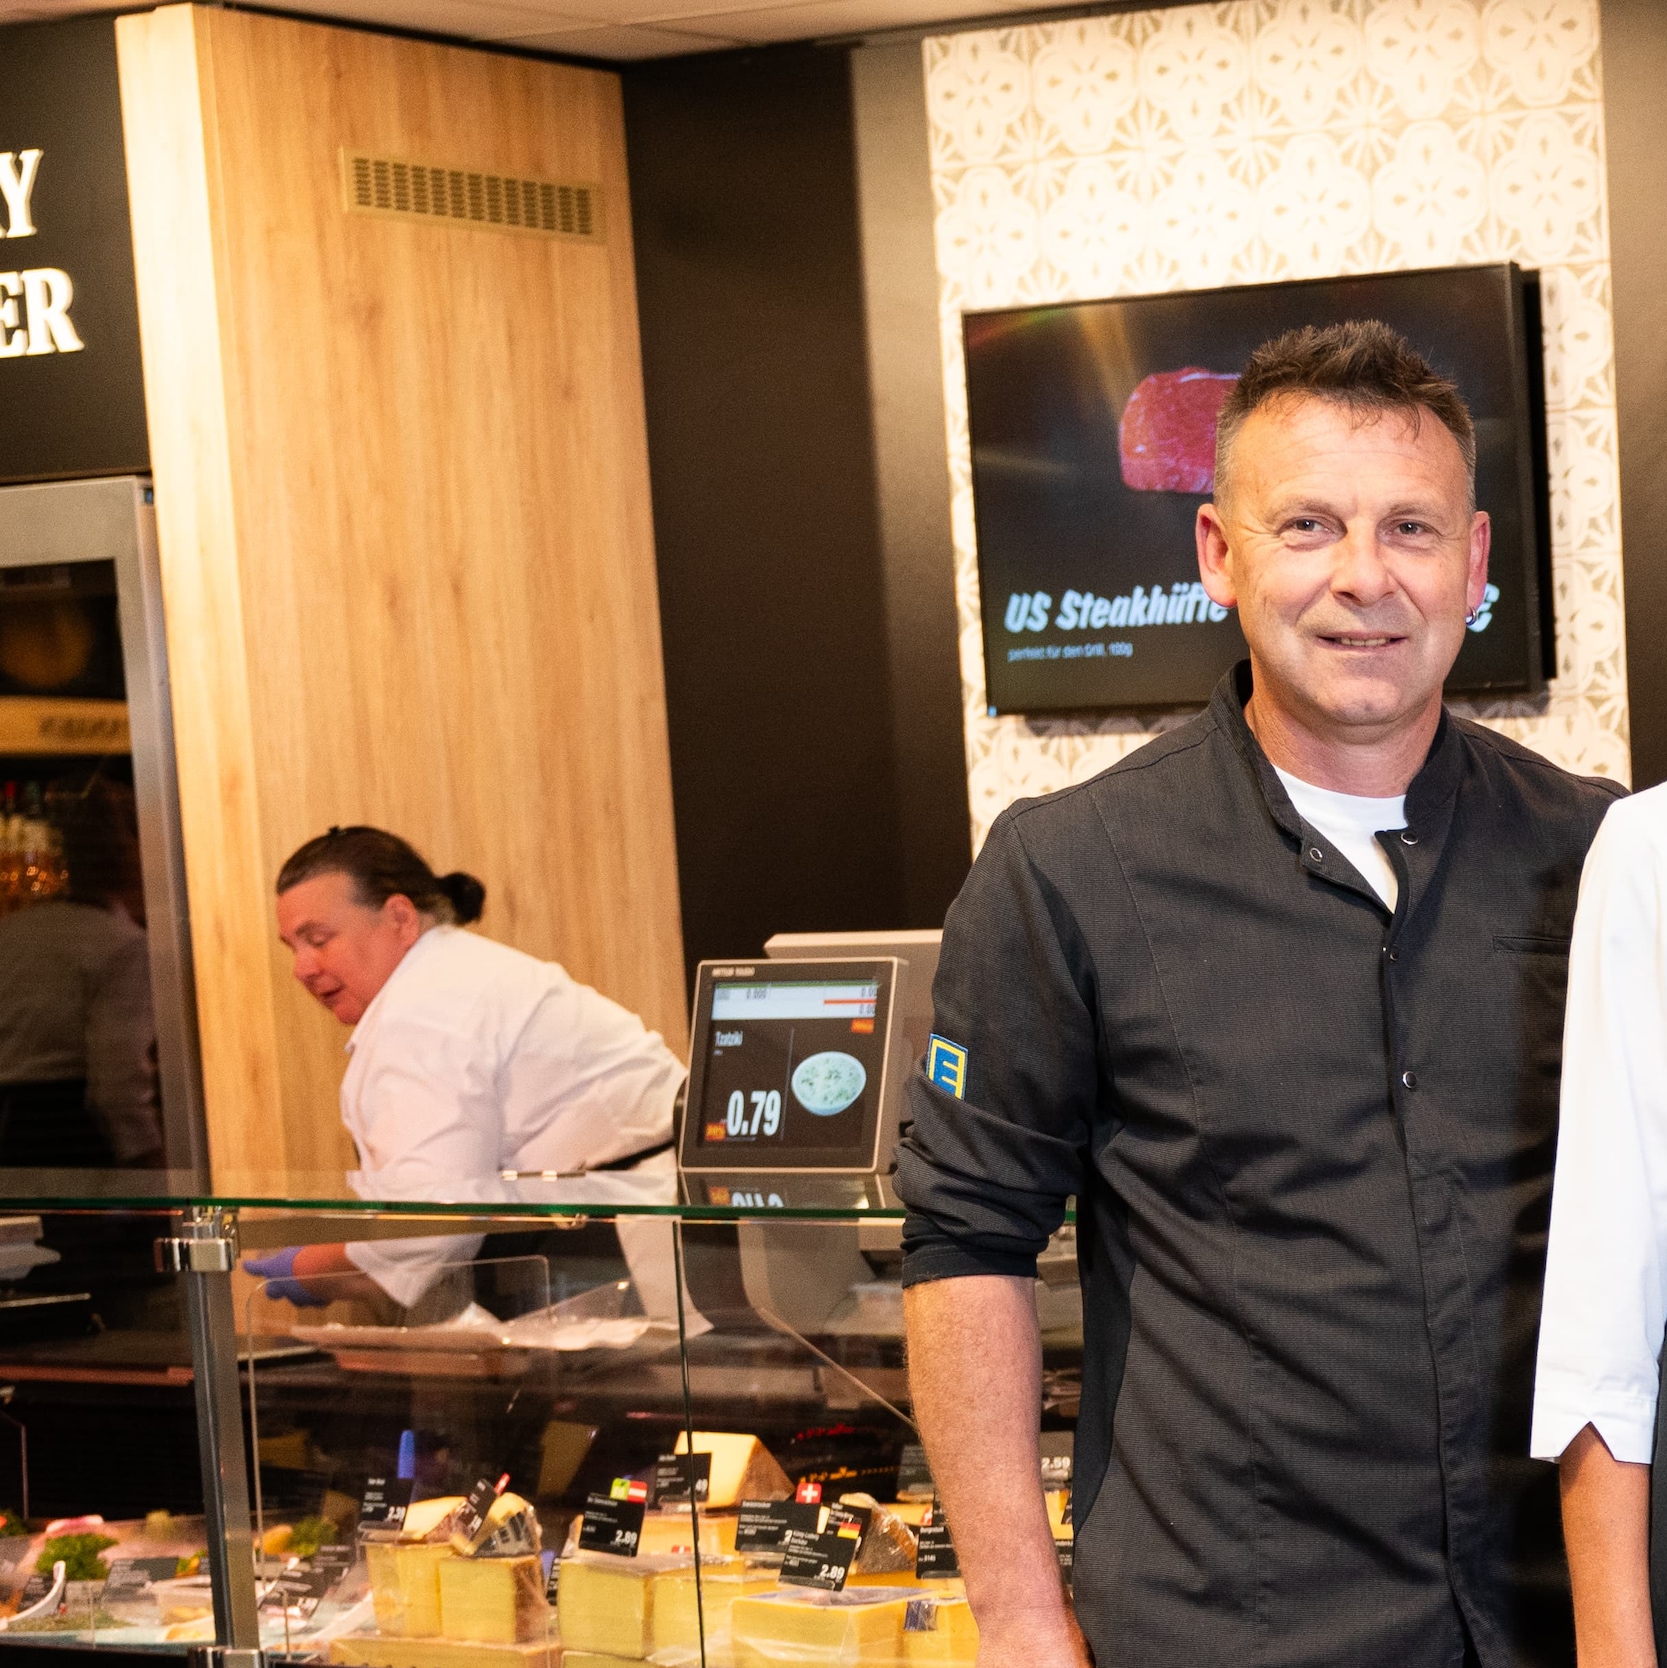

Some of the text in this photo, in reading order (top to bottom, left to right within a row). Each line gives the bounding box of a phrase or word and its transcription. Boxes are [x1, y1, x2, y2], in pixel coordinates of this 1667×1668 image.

[1004, 590, 1052, 633] US
[727, 1090, 782, 1136] 0.79
[820, 1563, 845, 1579] 2.89
